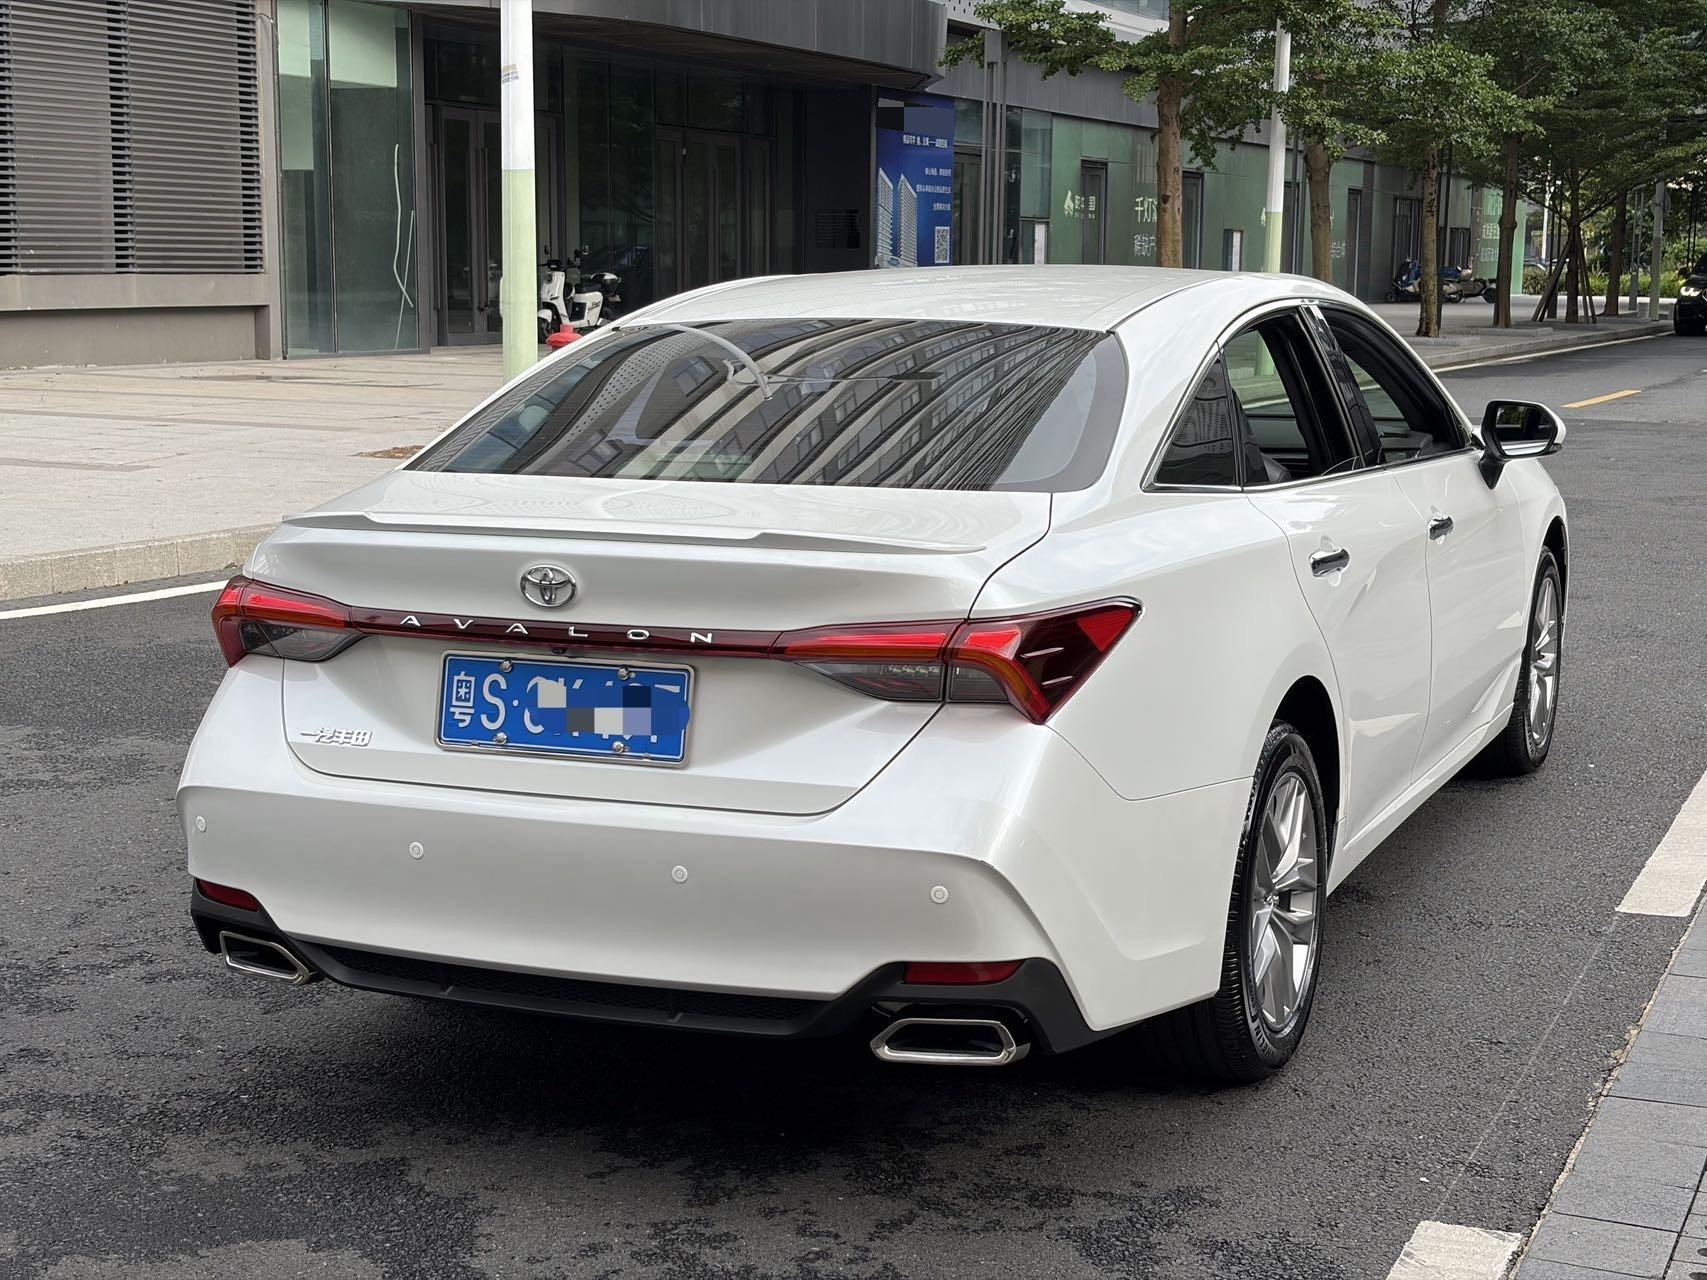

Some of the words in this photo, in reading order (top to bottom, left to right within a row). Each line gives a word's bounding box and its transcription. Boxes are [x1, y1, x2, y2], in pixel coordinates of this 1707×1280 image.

[1133, 234, 1158, 257] 稀缺产
[400, 615, 713, 644] AVALON
[300, 727, 374, 747] 一汽丰田
